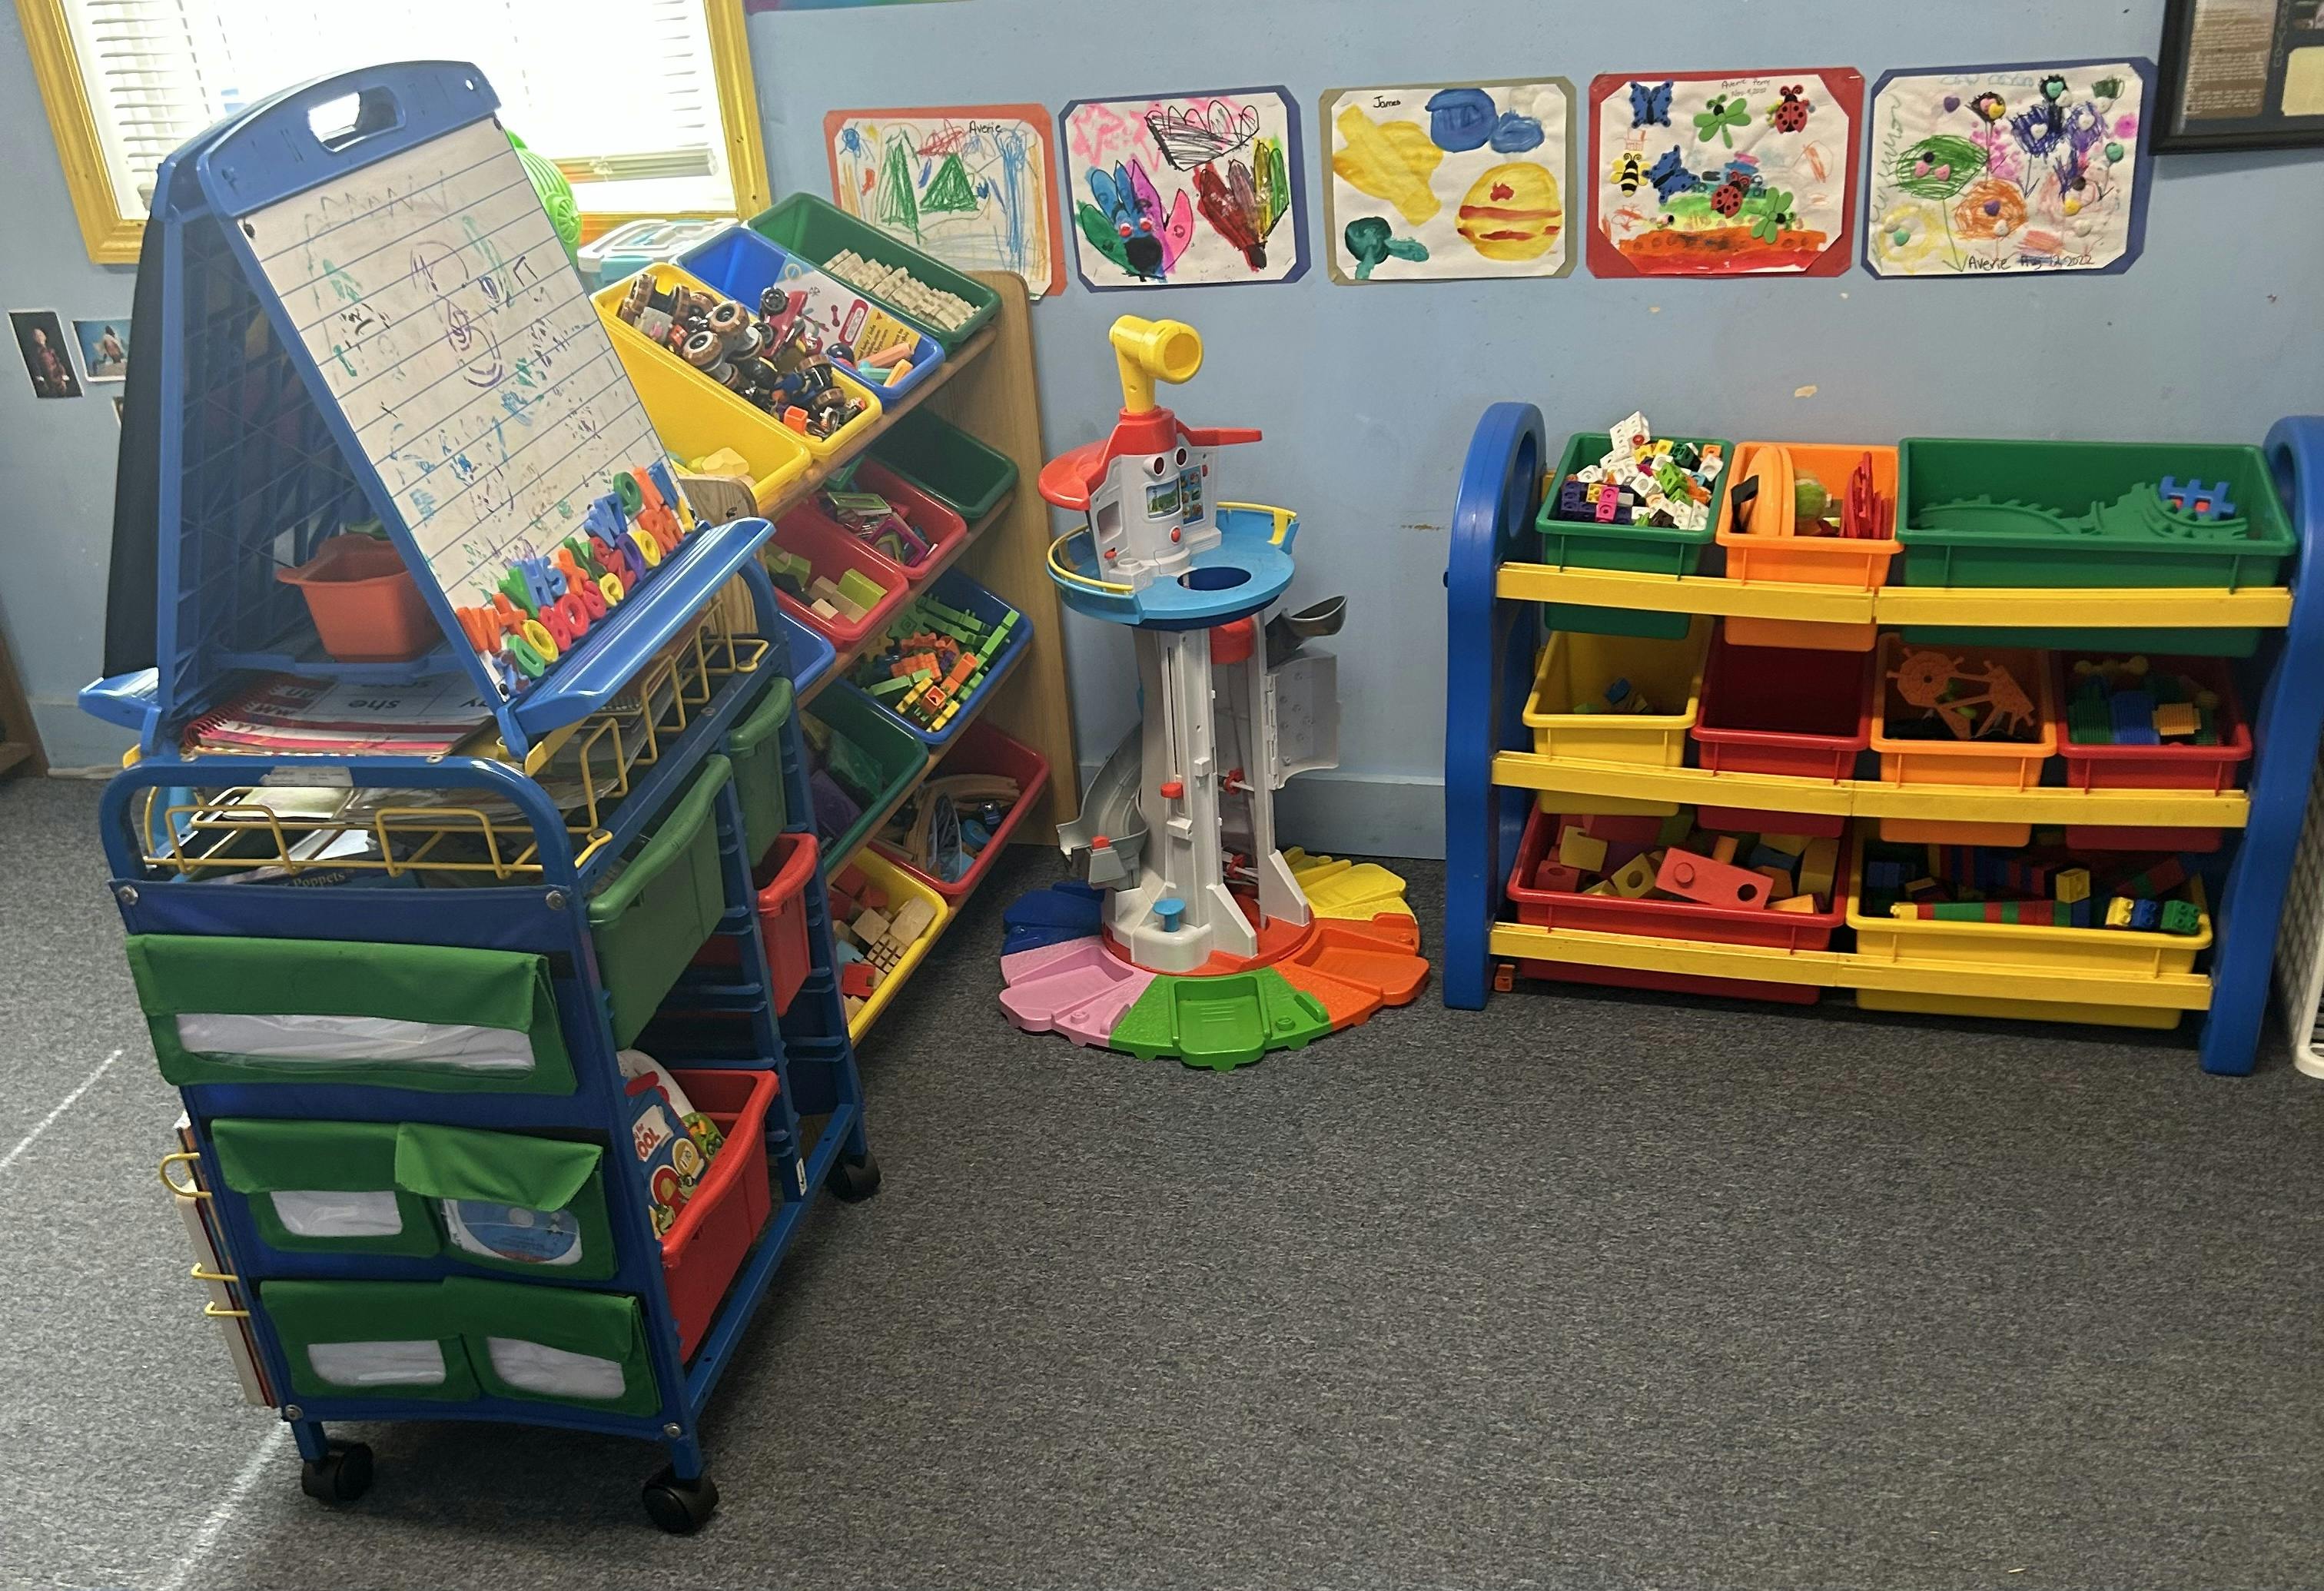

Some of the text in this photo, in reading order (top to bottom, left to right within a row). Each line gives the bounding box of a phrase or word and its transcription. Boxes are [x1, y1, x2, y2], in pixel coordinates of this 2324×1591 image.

[1373, 95, 1401, 108] James
[969, 120, 1002, 135] Averie
[1968, 256, 2010, 270] Averie
[2064, 254, 2095, 267] 2022
[348, 699, 400, 711] she
